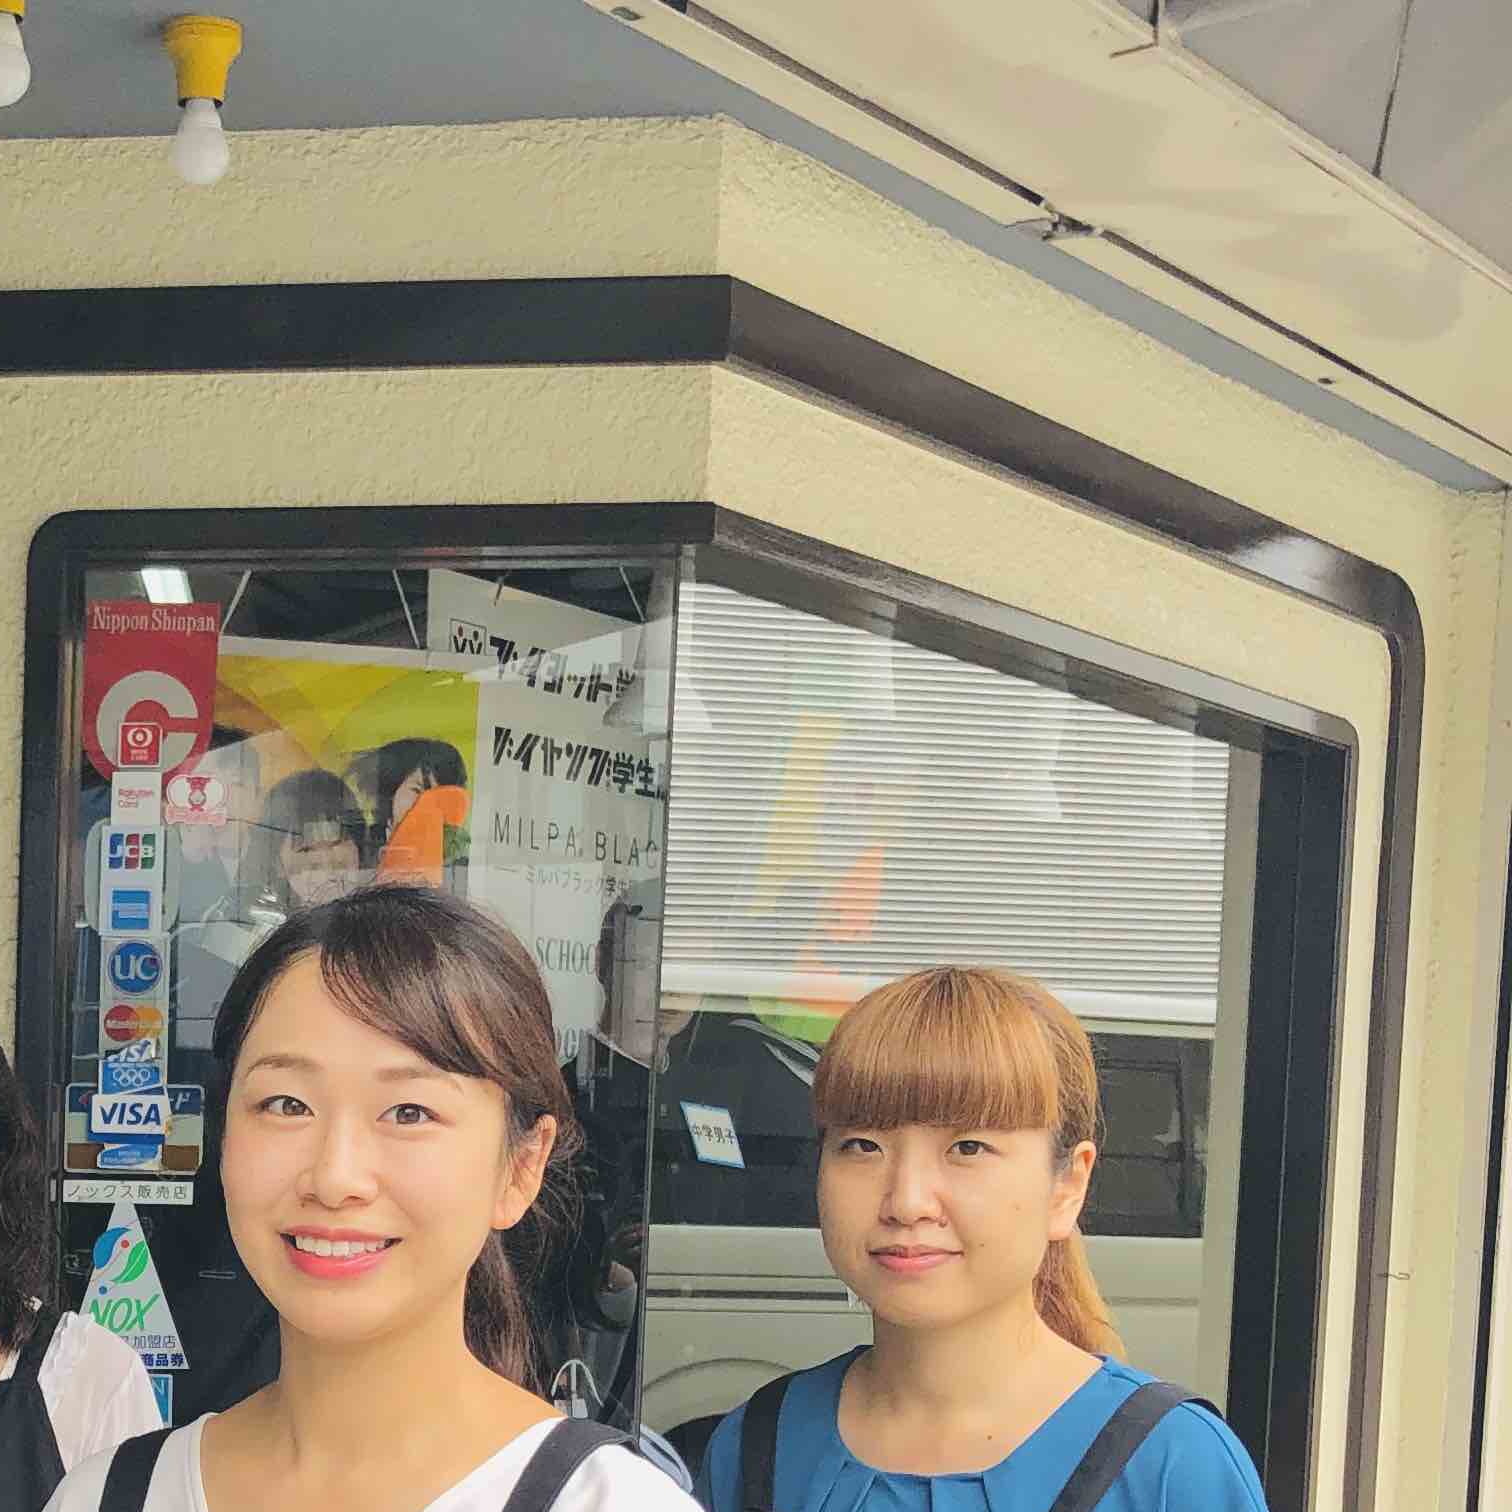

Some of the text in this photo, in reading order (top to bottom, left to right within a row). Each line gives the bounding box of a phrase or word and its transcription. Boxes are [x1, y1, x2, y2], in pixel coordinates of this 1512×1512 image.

[93, 606, 215, 636] Nippon Shinpan
[109, 833, 155, 869] JCB
[115, 954, 157, 980] UC
[99, 1103, 161, 1125] VISA
[67, 1184, 187, 1200] ノックス販売店
[90, 1293, 159, 1333] NOX
